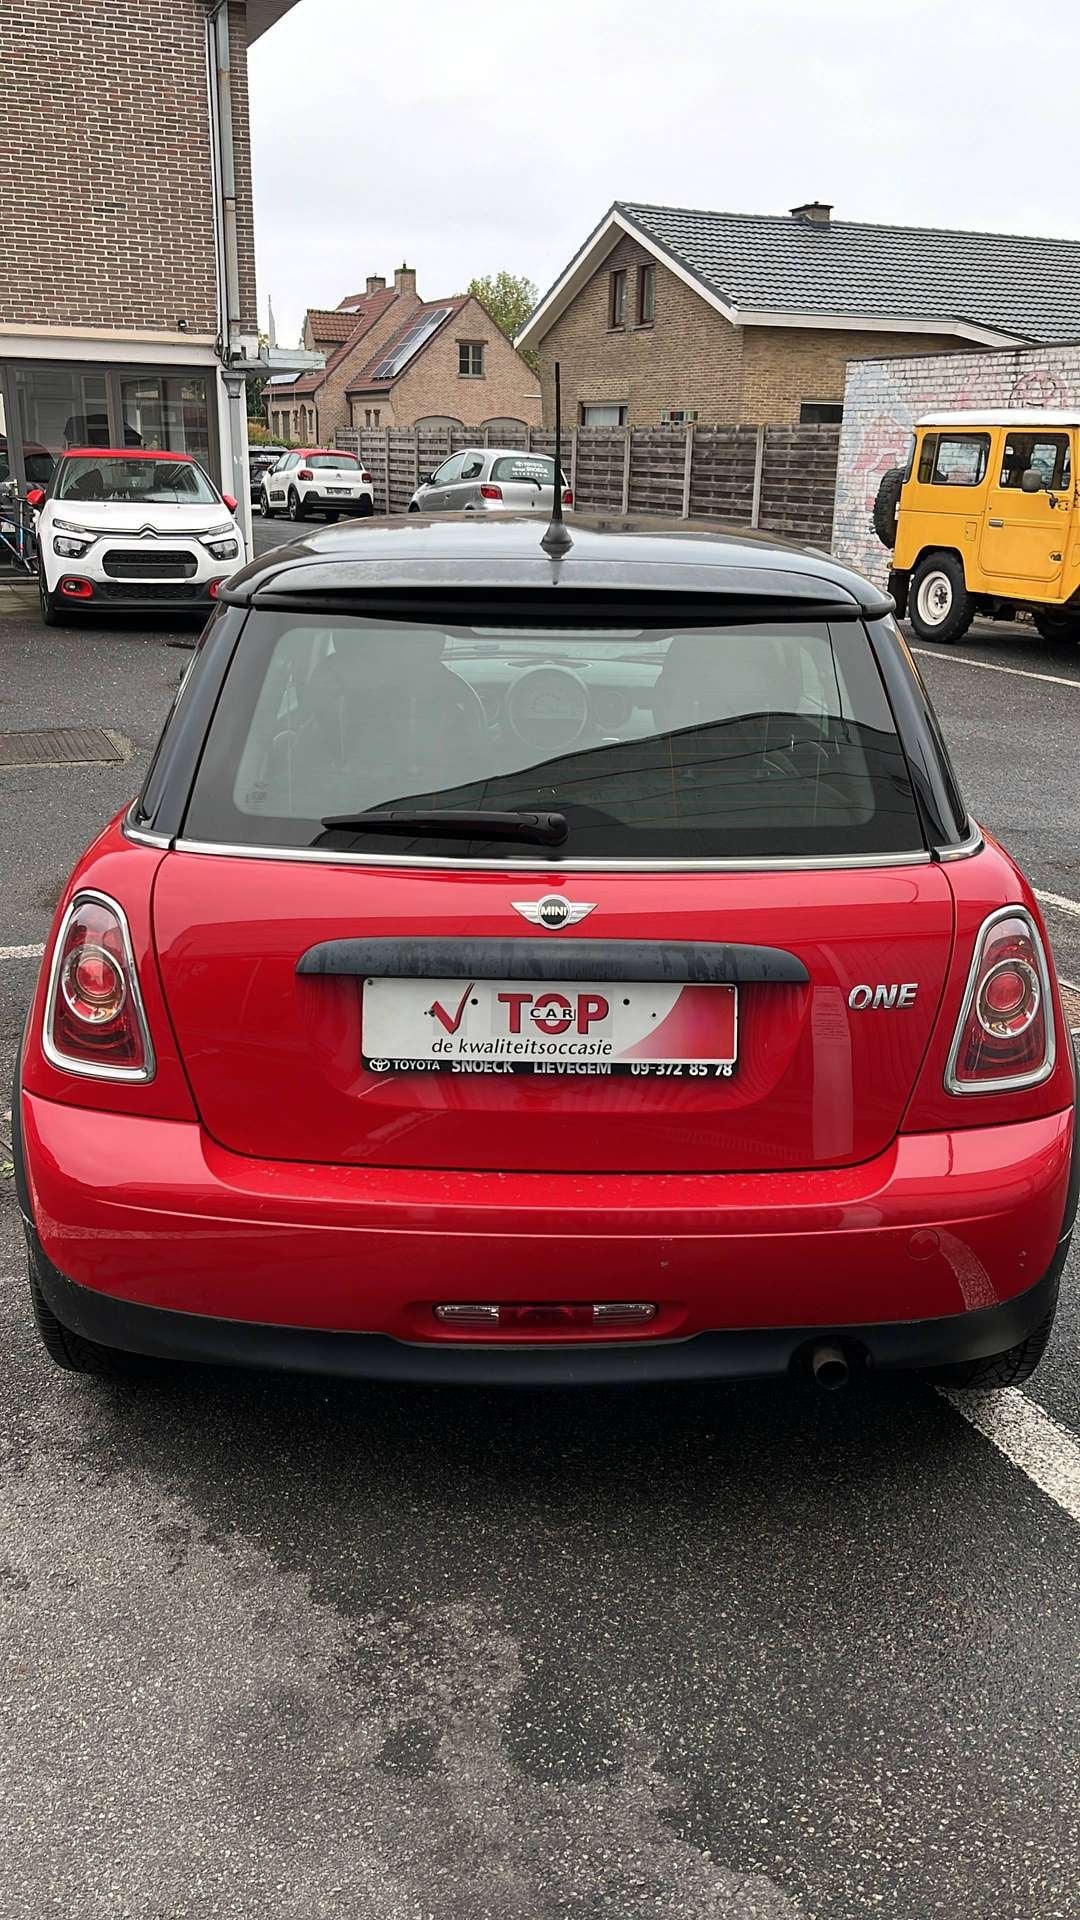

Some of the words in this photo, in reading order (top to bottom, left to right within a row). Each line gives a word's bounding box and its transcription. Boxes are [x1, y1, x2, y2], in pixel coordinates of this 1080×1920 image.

[540, 906, 567, 916] MINI
[848, 983, 918, 1009] ONE
[497, 993, 609, 1035] TOP
[530, 1008, 574, 1019] CAR
[431, 1038, 453, 1053] de
[459, 1038, 612, 1055] kwaliteitsoccasie
[393, 1059, 440, 1071] TOYOTA
[451, 1060, 514, 1073] SNOECK
[533, 1061, 612, 1074] LIEVEGEM
[630, 1063, 683, 1076] 09-372
[689, 1064, 708, 1077] 85
[714, 1064, 733, 1077] 78
